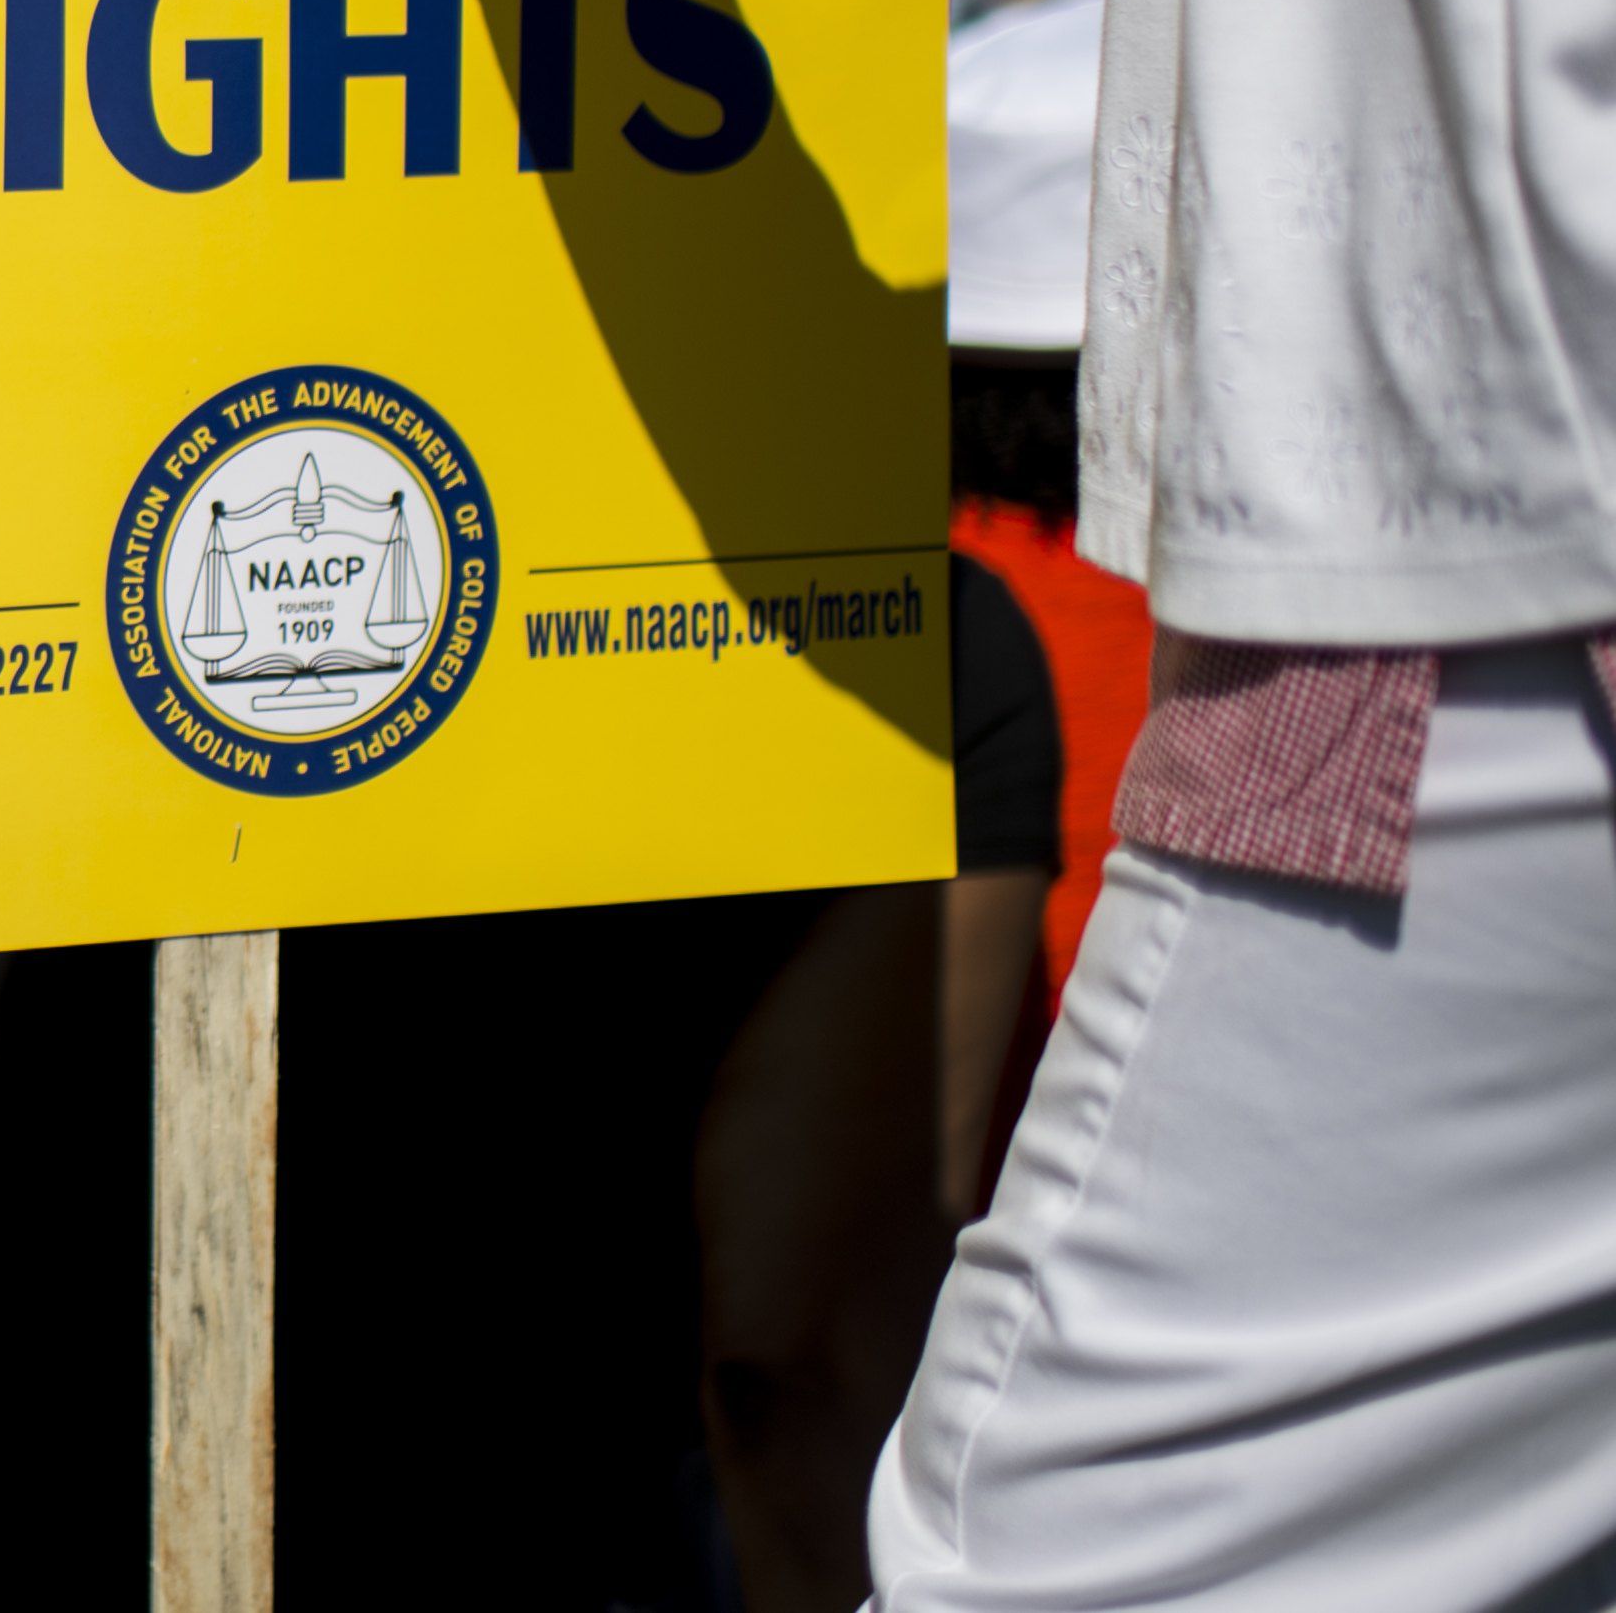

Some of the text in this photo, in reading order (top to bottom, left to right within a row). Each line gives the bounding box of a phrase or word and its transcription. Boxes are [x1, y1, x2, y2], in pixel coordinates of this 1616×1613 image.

[121, 381, 486, 778] NATIONAL ASSOCIATION FOR THE ADVANCEMENT OF COLORED PEOPLE
[248, 556, 366, 592] NAACP
[277, 600, 336, 614] FOUNDED
[525, 573, 922, 663] www.naacp.org/march
[278, 619, 335, 644] 1909
